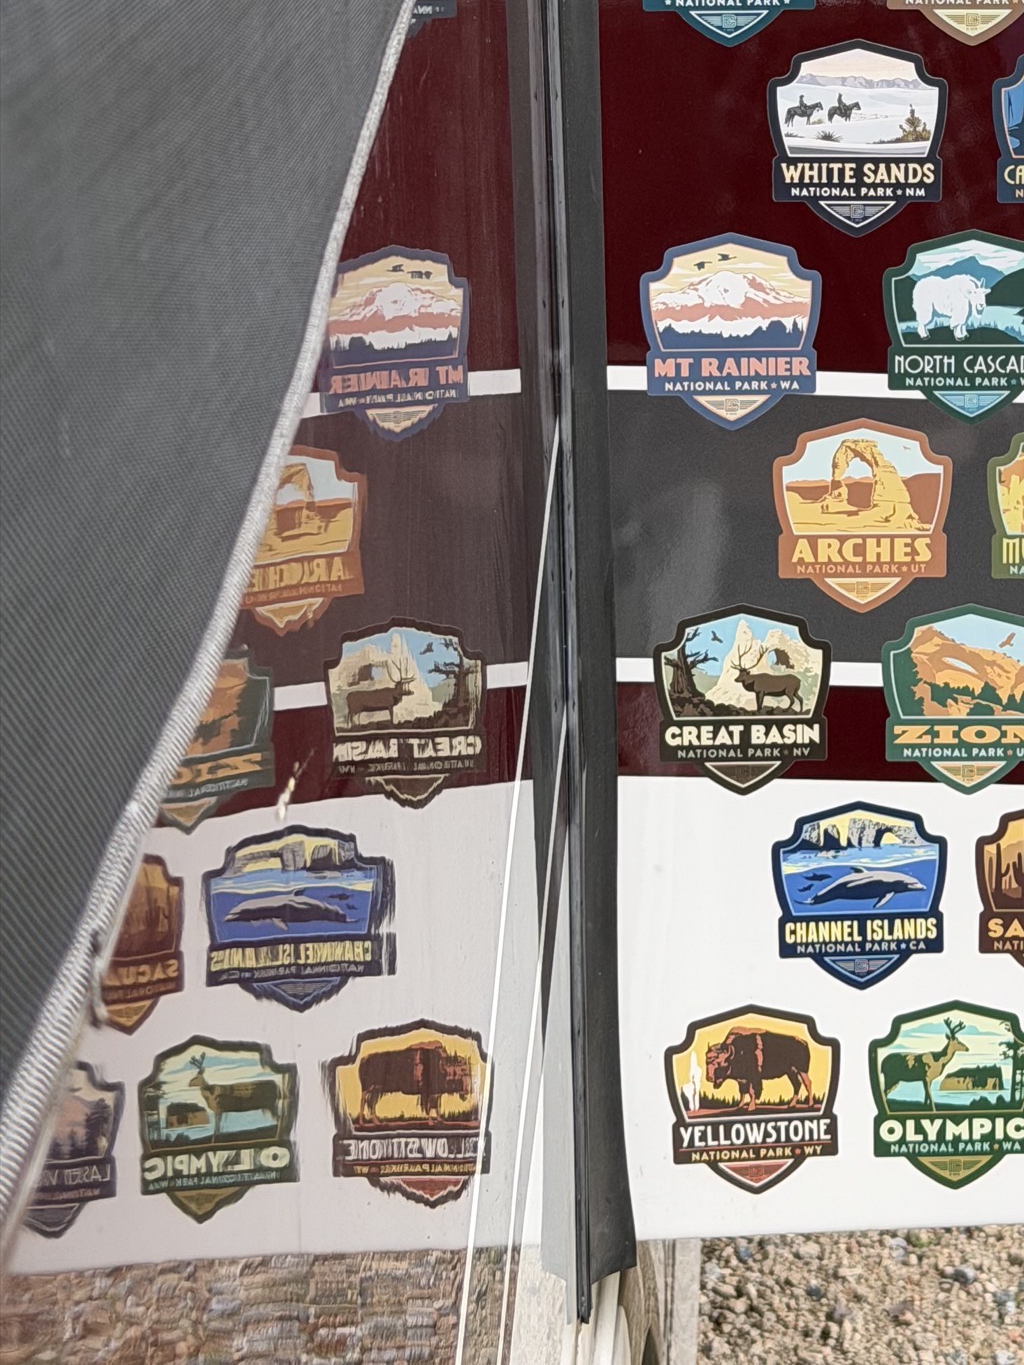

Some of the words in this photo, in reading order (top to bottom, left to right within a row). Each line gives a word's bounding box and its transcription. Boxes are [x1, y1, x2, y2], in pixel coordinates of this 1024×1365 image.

[780, 162, 857, 184] WHITE
[863, 162, 935, 184] SANDS
[654, 358, 694, 378] MT
[701, 356, 812, 377] RAINIER
[894, 354, 955, 374] NORTH
[905, 376, 971, 387] NATIONAL
[975, 376, 1008, 387] PARK
[791, 537, 932, 563] ARCHES
[664, 724, 745, 747] GREAT
[750, 723, 820, 745] BASIN
[903, 747, 968, 758] NATIONAL
[972, 747, 1004, 757] PARK
[785, 920, 863, 944] CHANNEL
[866, 917, 938, 941] ISLANDS
[679, 1117, 832, 1148] YELLOWSTONE
[890, 1142, 954, 1154] NATIONAL
[958, 1141, 990, 1152] PARK
[1002, 1141, 1021, 1151] WA
